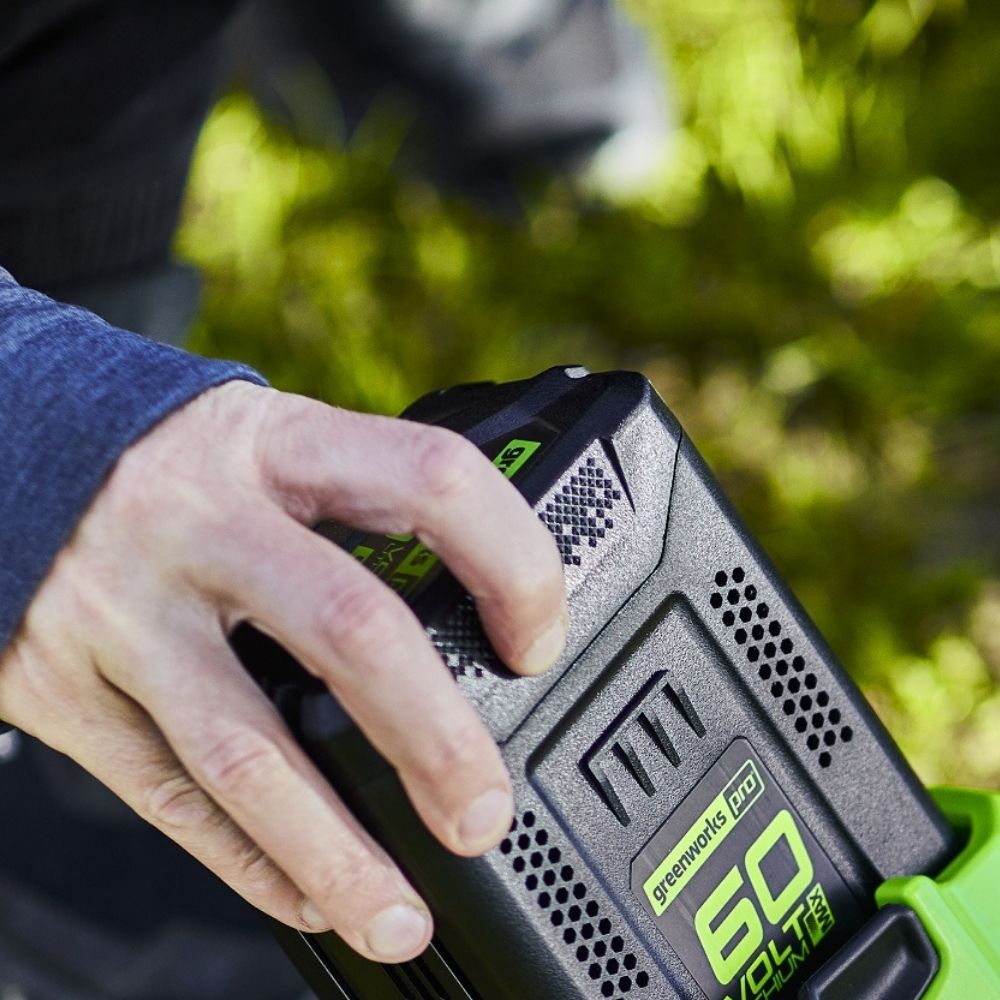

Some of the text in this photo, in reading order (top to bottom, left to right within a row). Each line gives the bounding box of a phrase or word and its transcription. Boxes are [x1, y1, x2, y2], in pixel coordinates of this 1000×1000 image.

[652, 772, 757, 906] greenworks pro
[694, 809, 814, 985] 60
[809, 887, 832, 934] MAX
